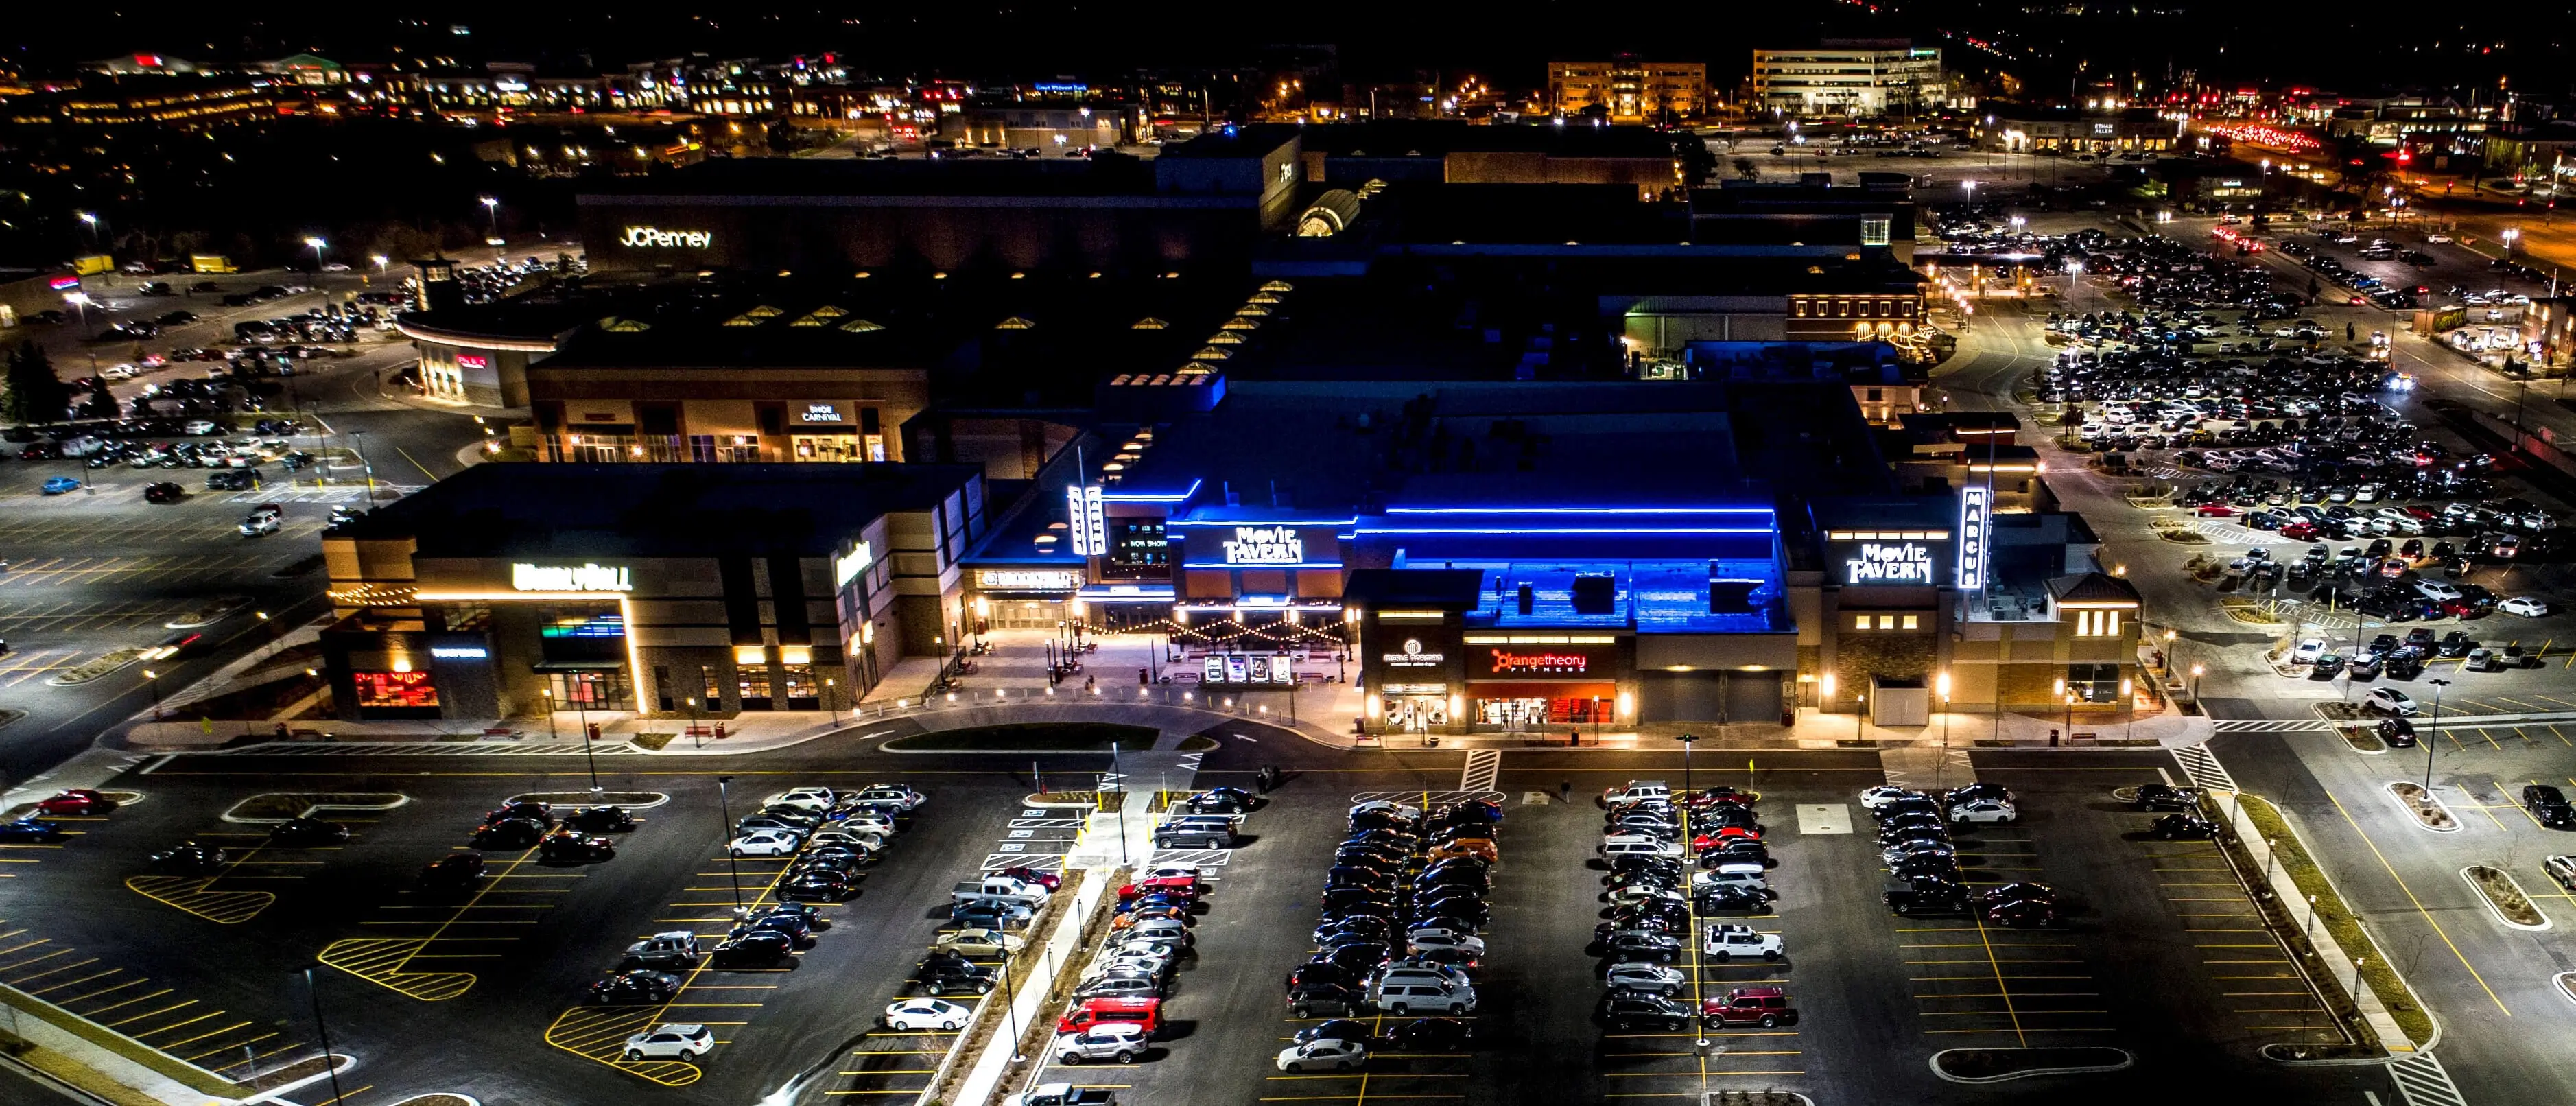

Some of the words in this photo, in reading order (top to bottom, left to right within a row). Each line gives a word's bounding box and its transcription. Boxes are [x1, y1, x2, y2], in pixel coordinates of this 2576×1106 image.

[620, 226, 711, 249] JCPenney
[1223, 539, 1302, 563] TAVERN
[1965, 493, 1981, 585] MARCUS
[1847, 558, 1932, 583] TAVERN
